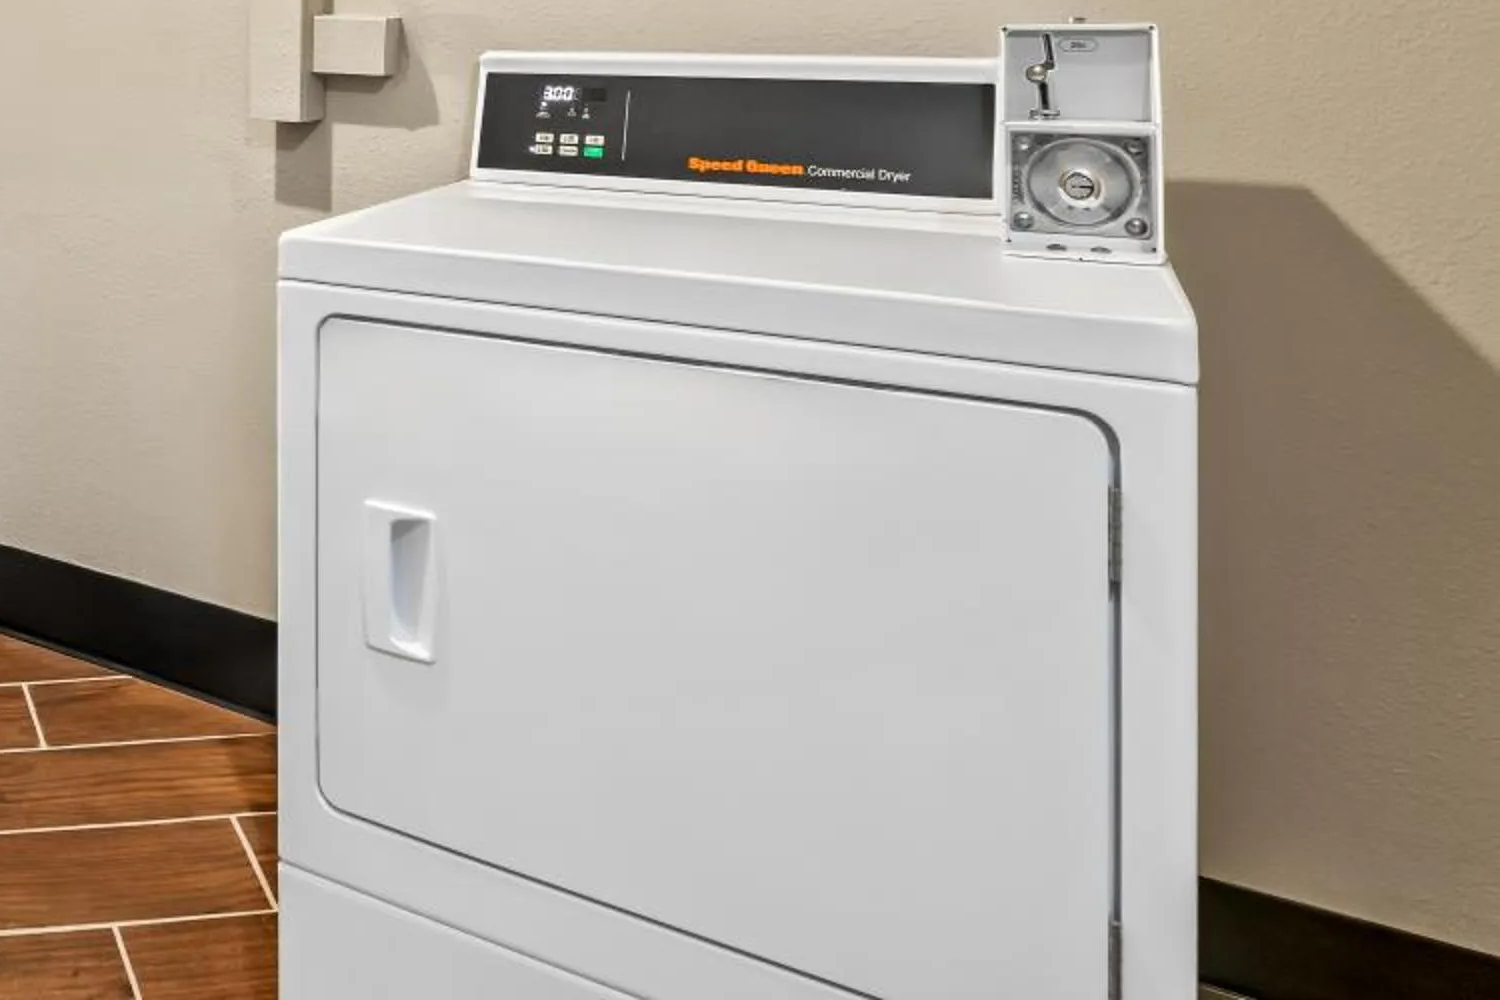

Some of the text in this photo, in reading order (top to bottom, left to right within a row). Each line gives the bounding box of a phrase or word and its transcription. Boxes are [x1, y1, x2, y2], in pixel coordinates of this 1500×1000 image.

[688, 157, 911, 183] Speed Queen Commercial Dryer
